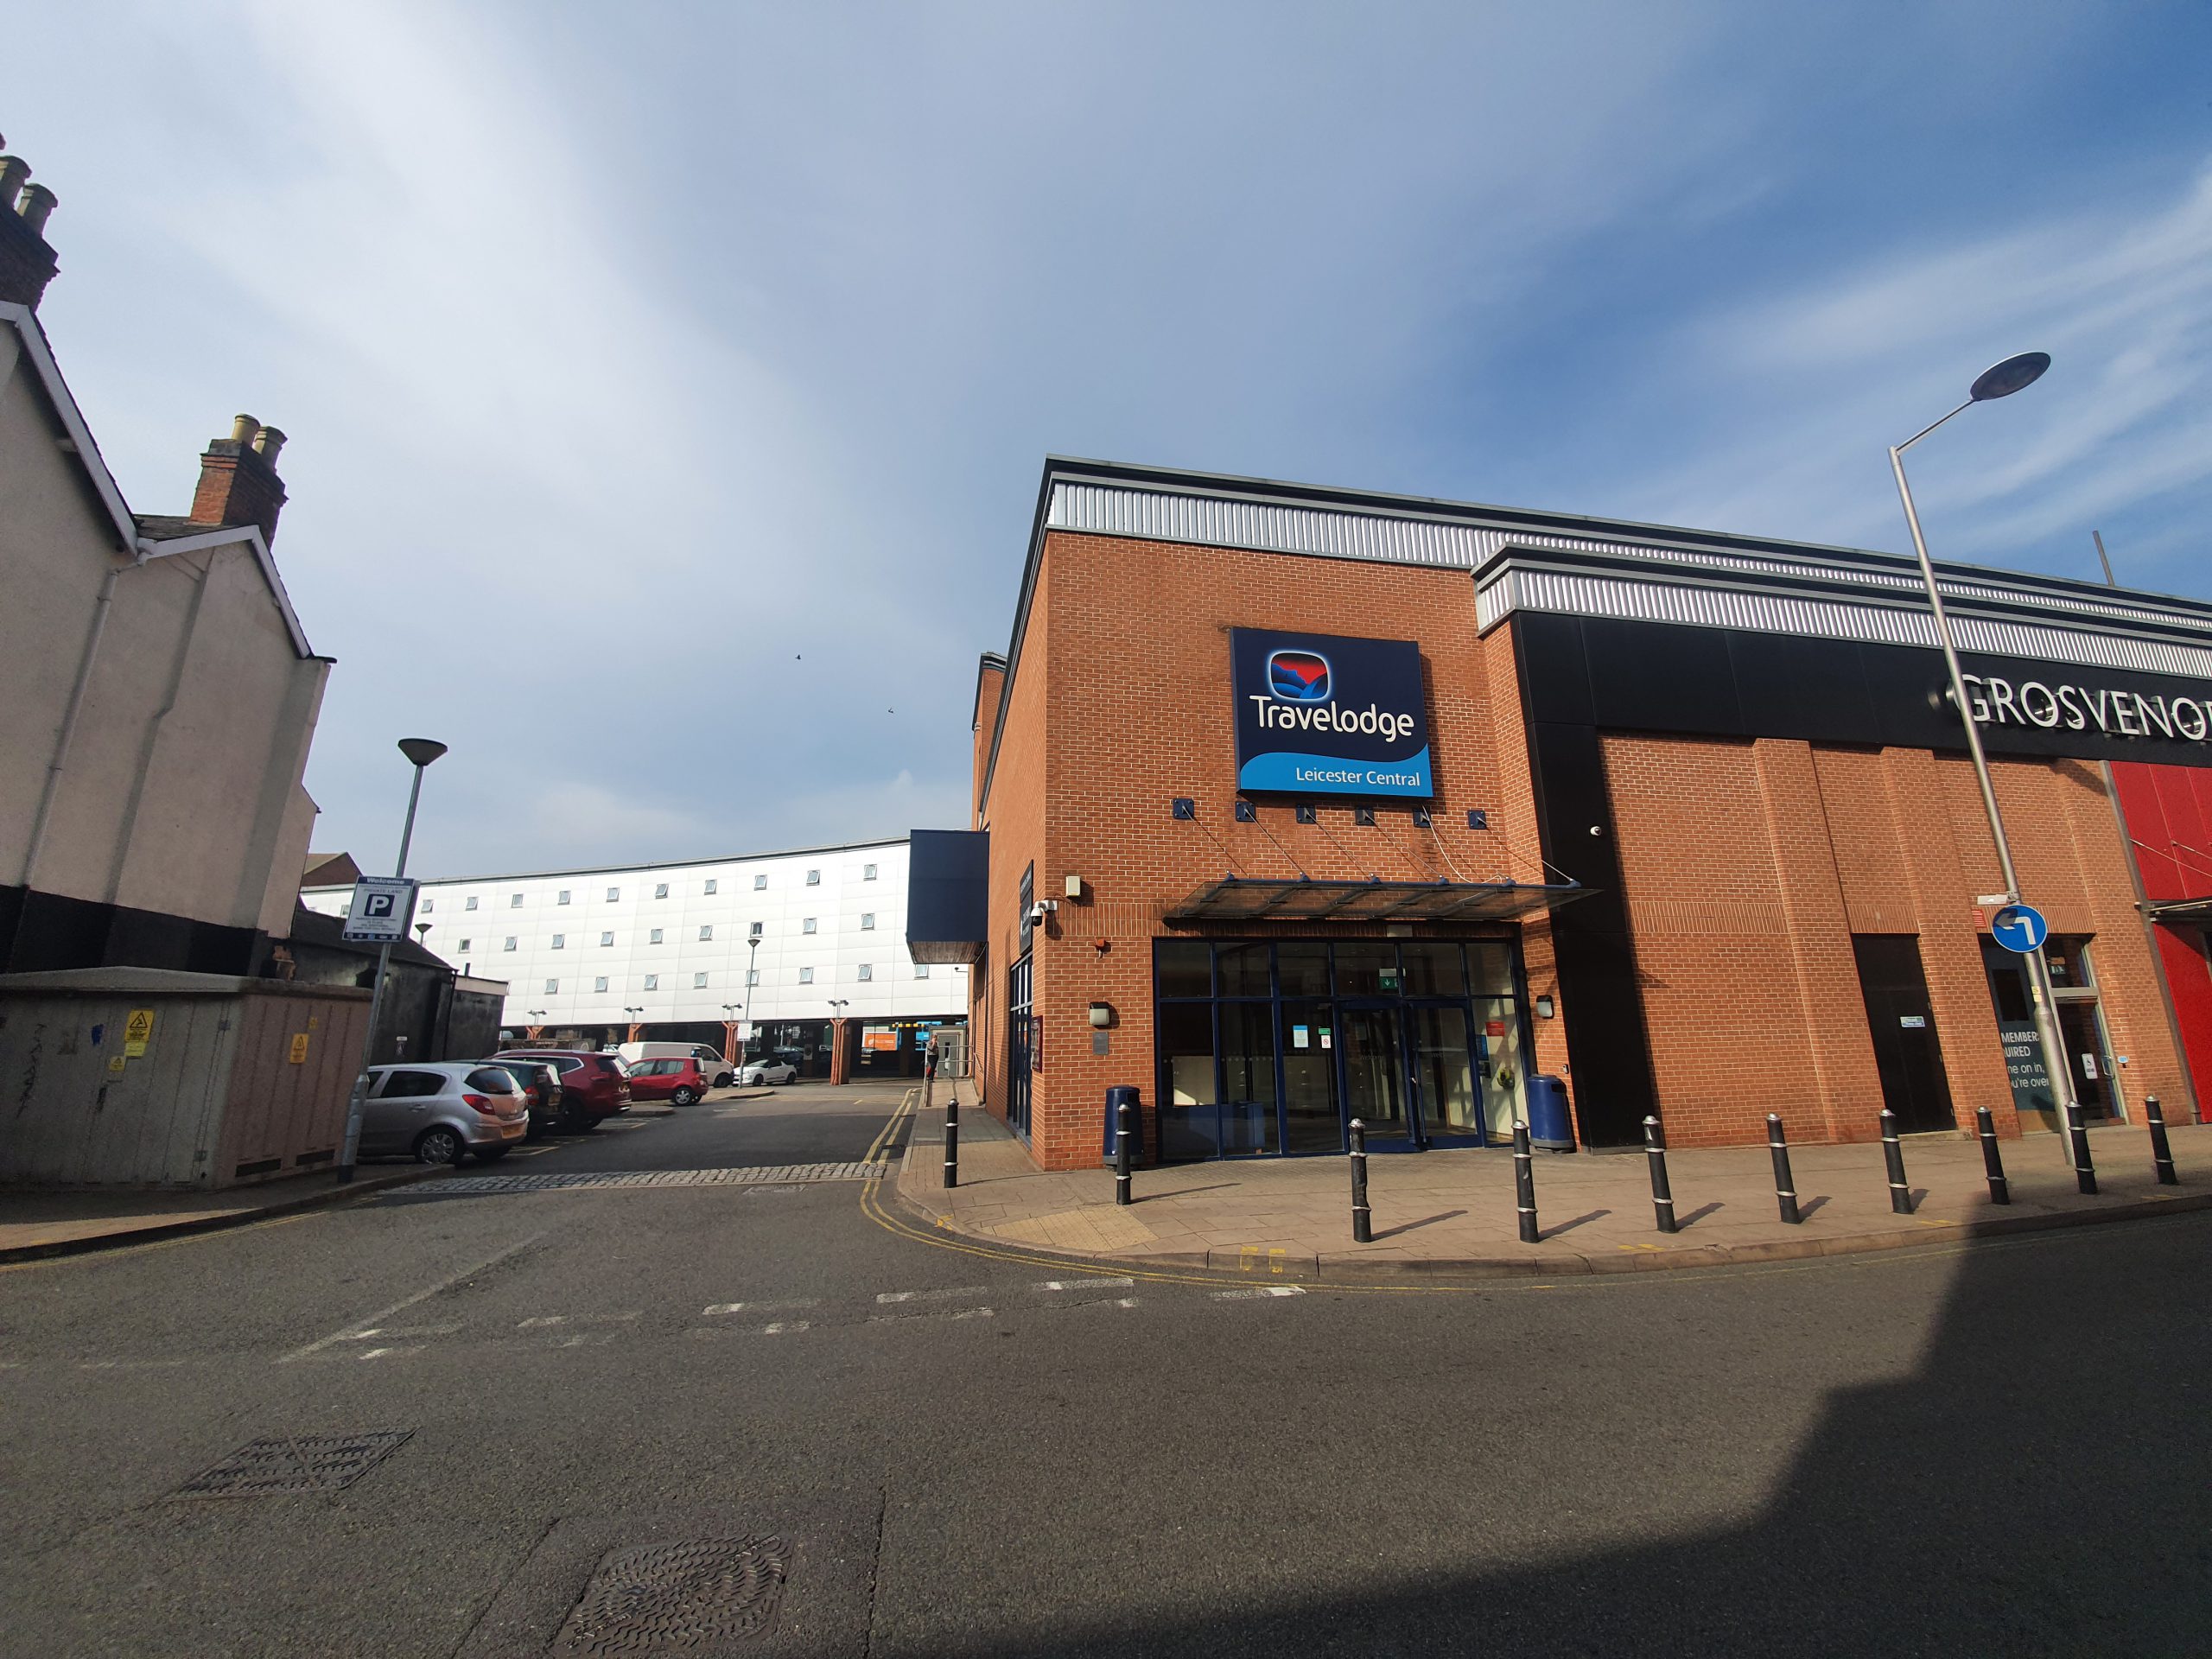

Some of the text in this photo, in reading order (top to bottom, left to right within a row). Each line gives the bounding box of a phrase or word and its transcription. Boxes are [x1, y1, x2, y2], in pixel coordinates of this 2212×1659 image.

[1954, 674, 2212, 740] GROSVENO
[1249, 695, 1414, 742] Travelodge
[1296, 767, 1421, 786] Leicester Central
[369, 895, 390, 915] P
[2020, 1065, 2032, 1073] on
